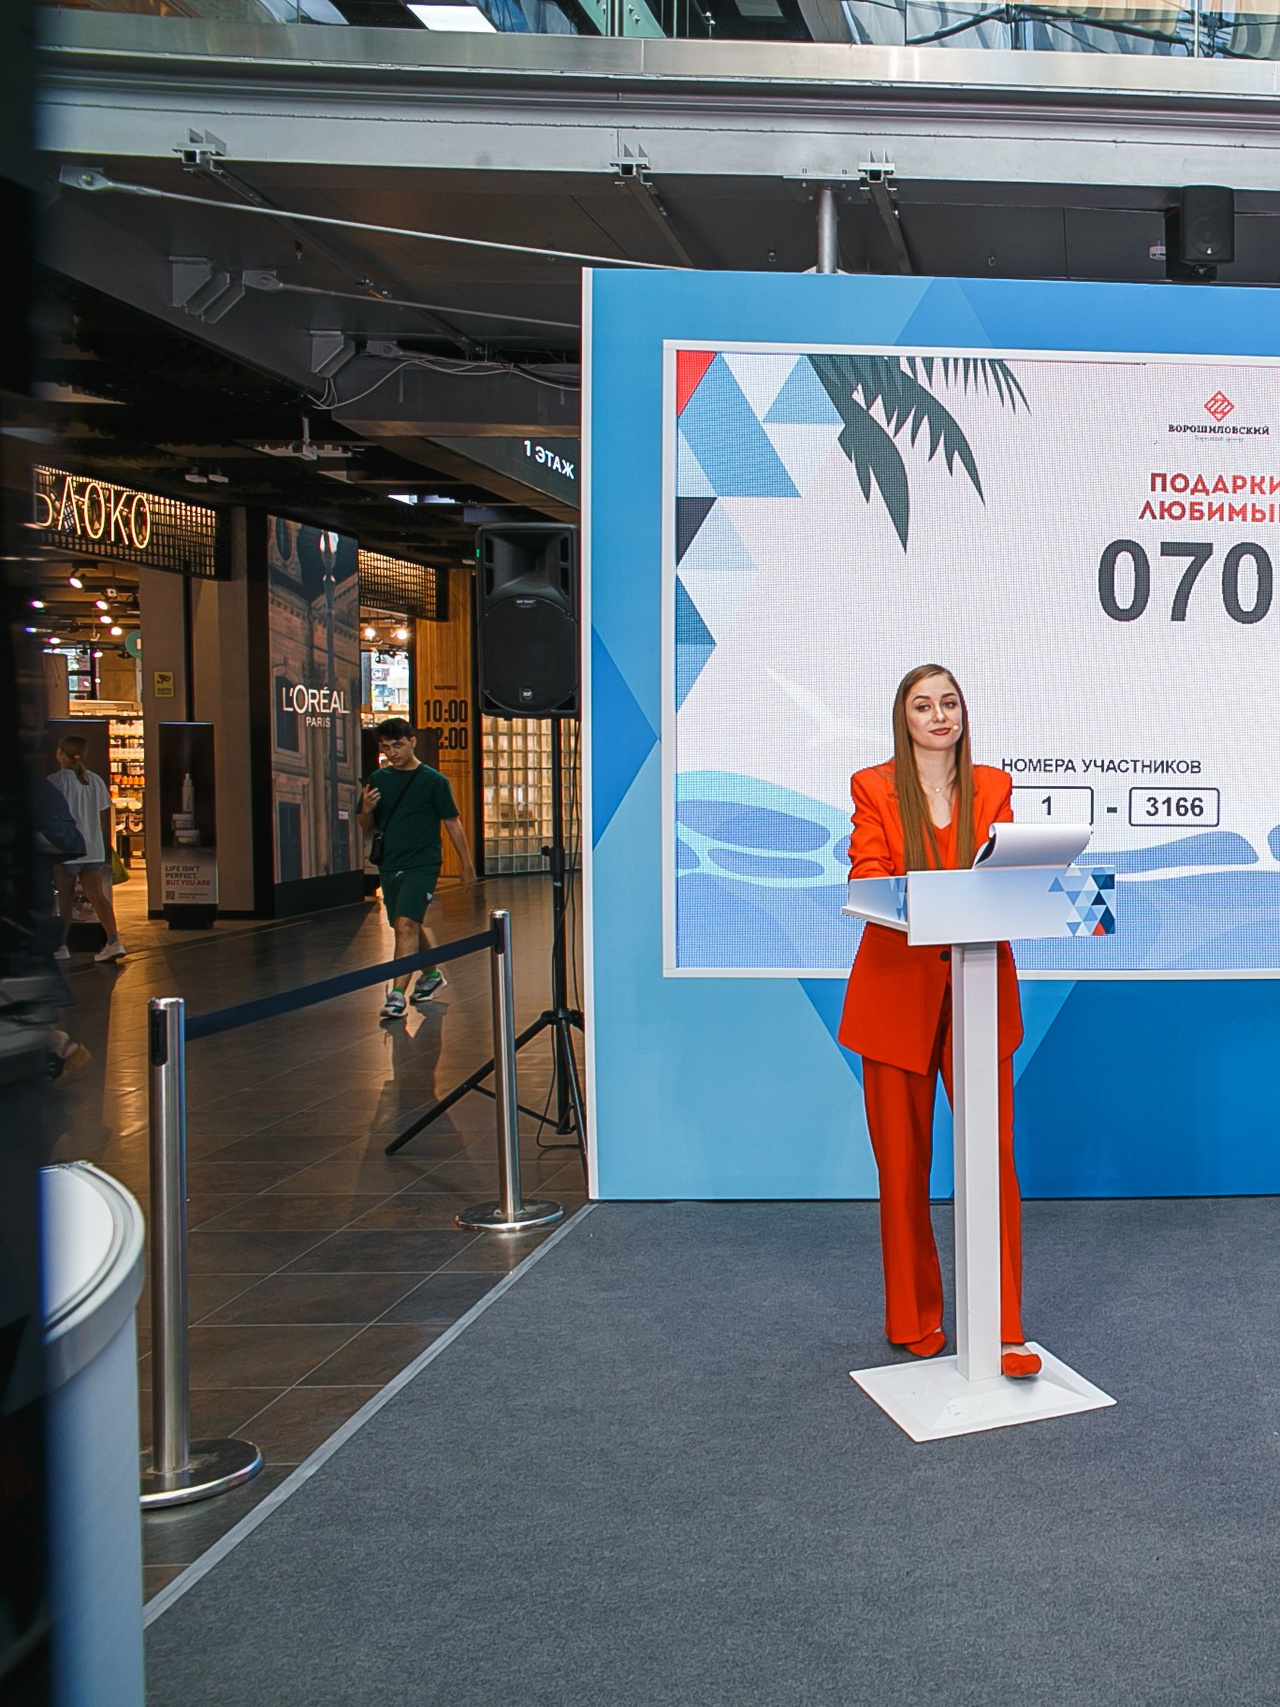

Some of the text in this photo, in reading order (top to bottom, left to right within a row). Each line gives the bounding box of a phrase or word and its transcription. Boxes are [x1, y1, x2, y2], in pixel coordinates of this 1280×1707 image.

[1168, 424, 1270, 436] ВОРОШИЛОВСКИЙ
[524, 440, 575, 480] 1 ЭТАЖ
[282, 684, 351, 714] L'ORÉAL
[424, 699, 468, 723] 10:00
[1001, 758, 1202, 774] НОМЕРА УЧАСТНИКОВ
[1041, 796, 1052, 816] 1
[1145, 796, 1204, 817] 3166
[165, 872, 199, 880] PERFECT,
